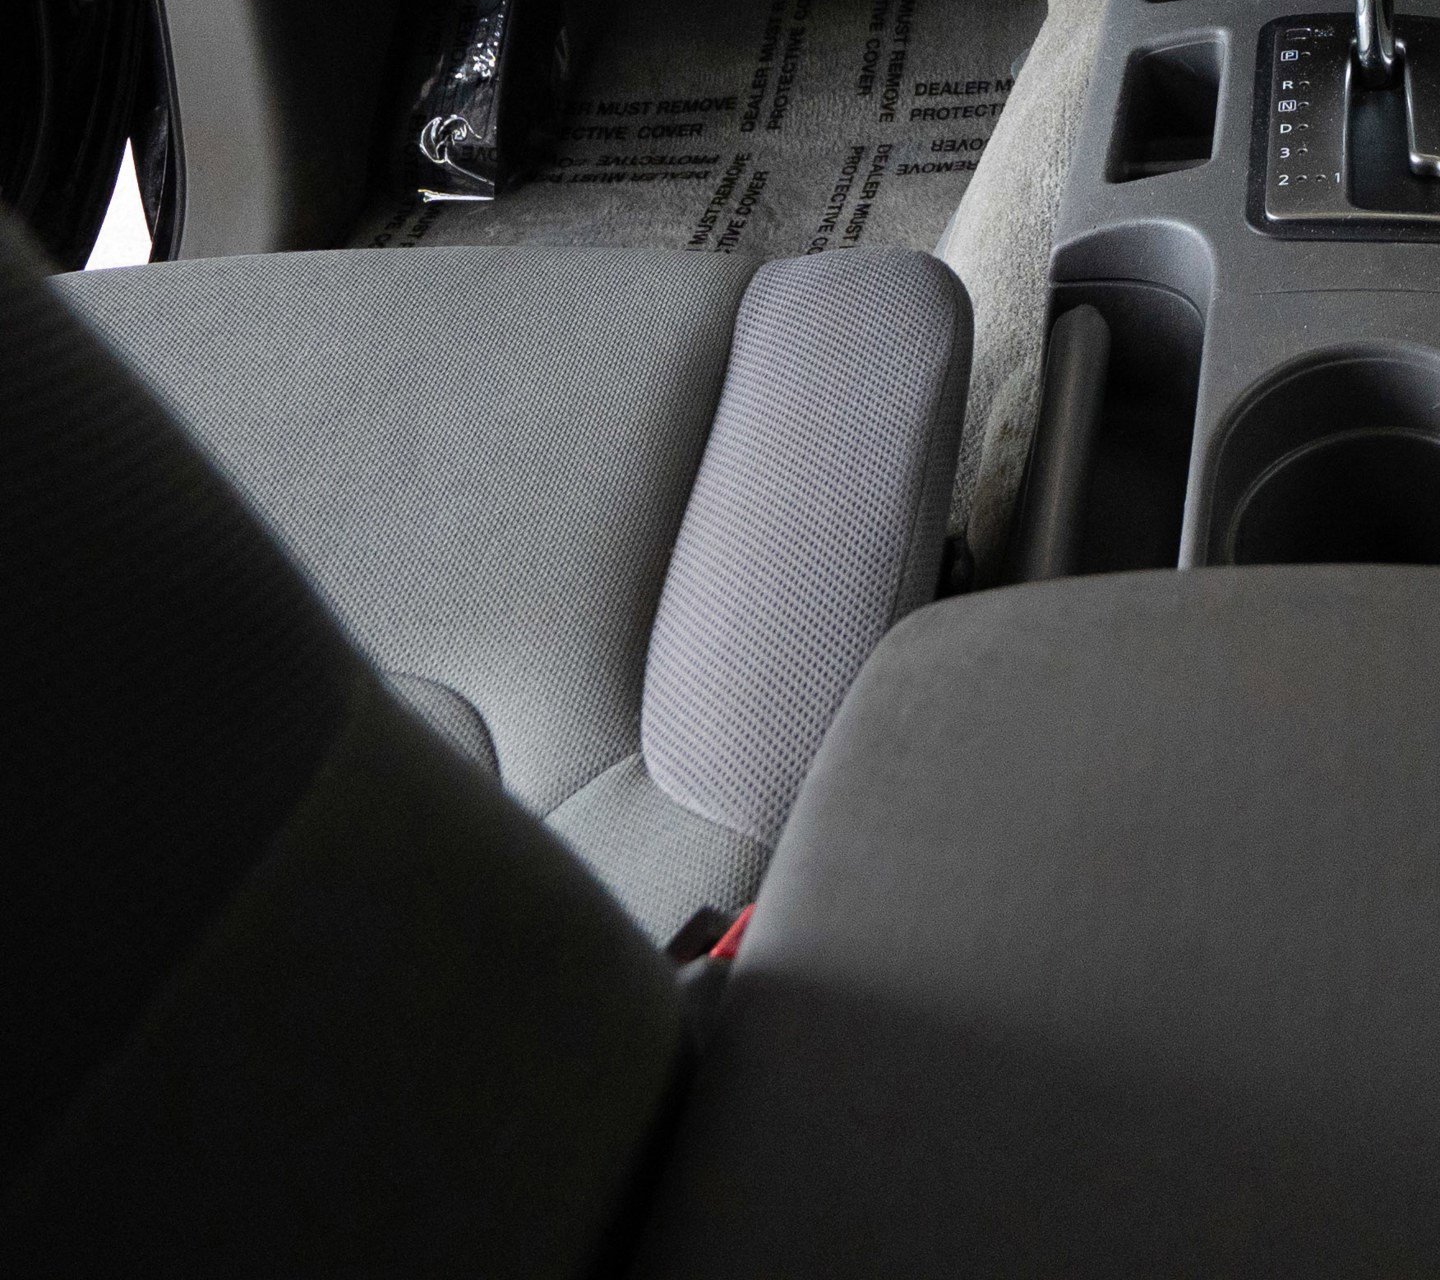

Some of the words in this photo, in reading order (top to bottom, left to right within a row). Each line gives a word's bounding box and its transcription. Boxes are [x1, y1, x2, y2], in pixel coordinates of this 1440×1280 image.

[893, 0, 916, 46] MUST
[1285, 52, 1295, 60] P
[741, 66, 772, 132] DEALER
[759, 16, 782, 63] MUST
[857, 38, 881, 96] COVER
[767, 26, 806, 130] PROTECTIVE
[879, 49, 907, 123] REMOVE
[1282, 80, 1294, 90] R
[913, 80, 989, 96] DEALER
[597, 100, 653, 117] MUST
[656, 96, 738, 116] REMOVE
[1282, 101, 1293, 111] N
[638, 123, 704, 141] COVER
[1280, 123, 1292, 134] D
[931, 137, 990, 152] OVER
[1280, 147, 1290, 159] 3
[596, 154, 720, 167] PROTECTIVE
[630, 170, 711, 183] DEALER
[860, 143, 893, 200] DEALER
[1279, 174, 1289, 186] 2
[1334, 172, 1341, 183] 1
[687, 207, 721, 246] MUST
[710, 152, 752, 207] REMOVE
[736, 170, 770, 216] COVER
[817, 145, 865, 234] PROTECTIVE
[843, 203, 872, 241] MUST
